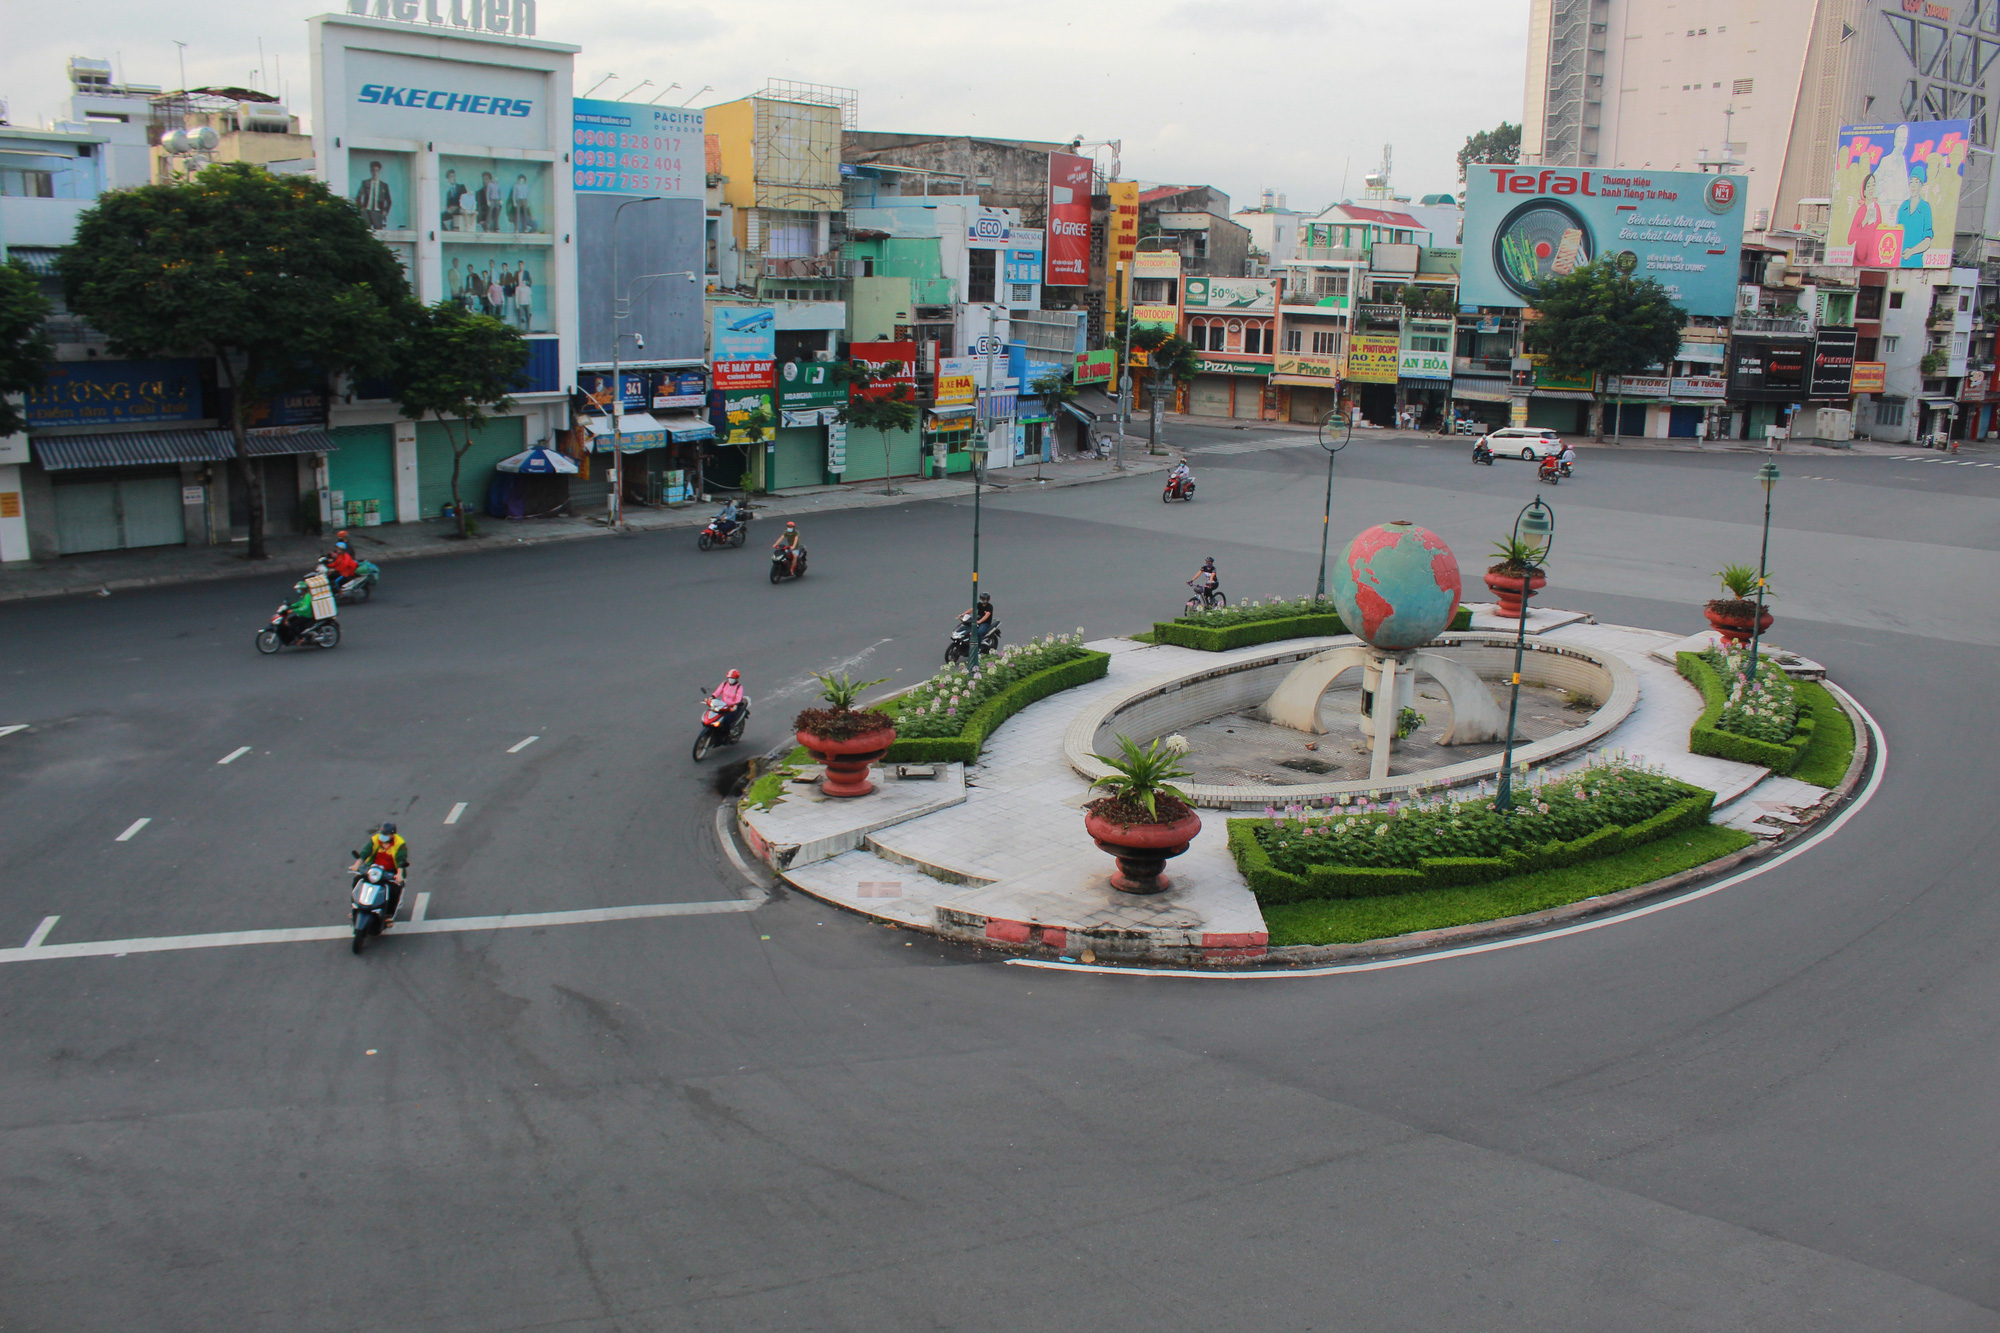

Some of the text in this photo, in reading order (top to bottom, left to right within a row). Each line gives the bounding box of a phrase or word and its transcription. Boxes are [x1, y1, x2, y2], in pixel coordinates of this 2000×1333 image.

[358, 84, 533, 117] SKECHERS
[654, 111, 703, 124] PACIFIC
[654, 125, 703, 133] OUTDOOR
[575, 129, 681, 152] 0908 328 017
[575, 150, 681, 172] 0933 462 404
[575, 170, 681, 191] 0977 755 751
[1489, 169, 1597, 196] Tefal
[1603, 175, 1651, 188] Thương Hiệu
[1601, 187, 1621, 197] Danh
[1658, 189, 1678, 202] Pháp
[980, 221, 999, 235] ECO
[1062, 221, 1088, 237] GREE
[1694, 218, 1717, 232] gian
[1211, 288, 1236, 299] 50%
[1134, 309, 1175, 319] PHOTOCOPY
[980, 340, 998, 352] EO
[1363, 344, 1398, 354] PHOTOCOPY
[732, 361, 751, 373] MÁY
[754, 362, 772, 372] BAY
[1203, 360, 1234, 373] PIZZA
[1297, 362, 1331, 376] iPhone
[1401, 356, 1449, 370] AN HÒA
[946, 380, 955, 388] XE
[956, 375, 971, 388] HÀ
[626, 382, 642, 395] 341
[113, 405, 123, 416] &
[633, 431, 665, 443] 341
